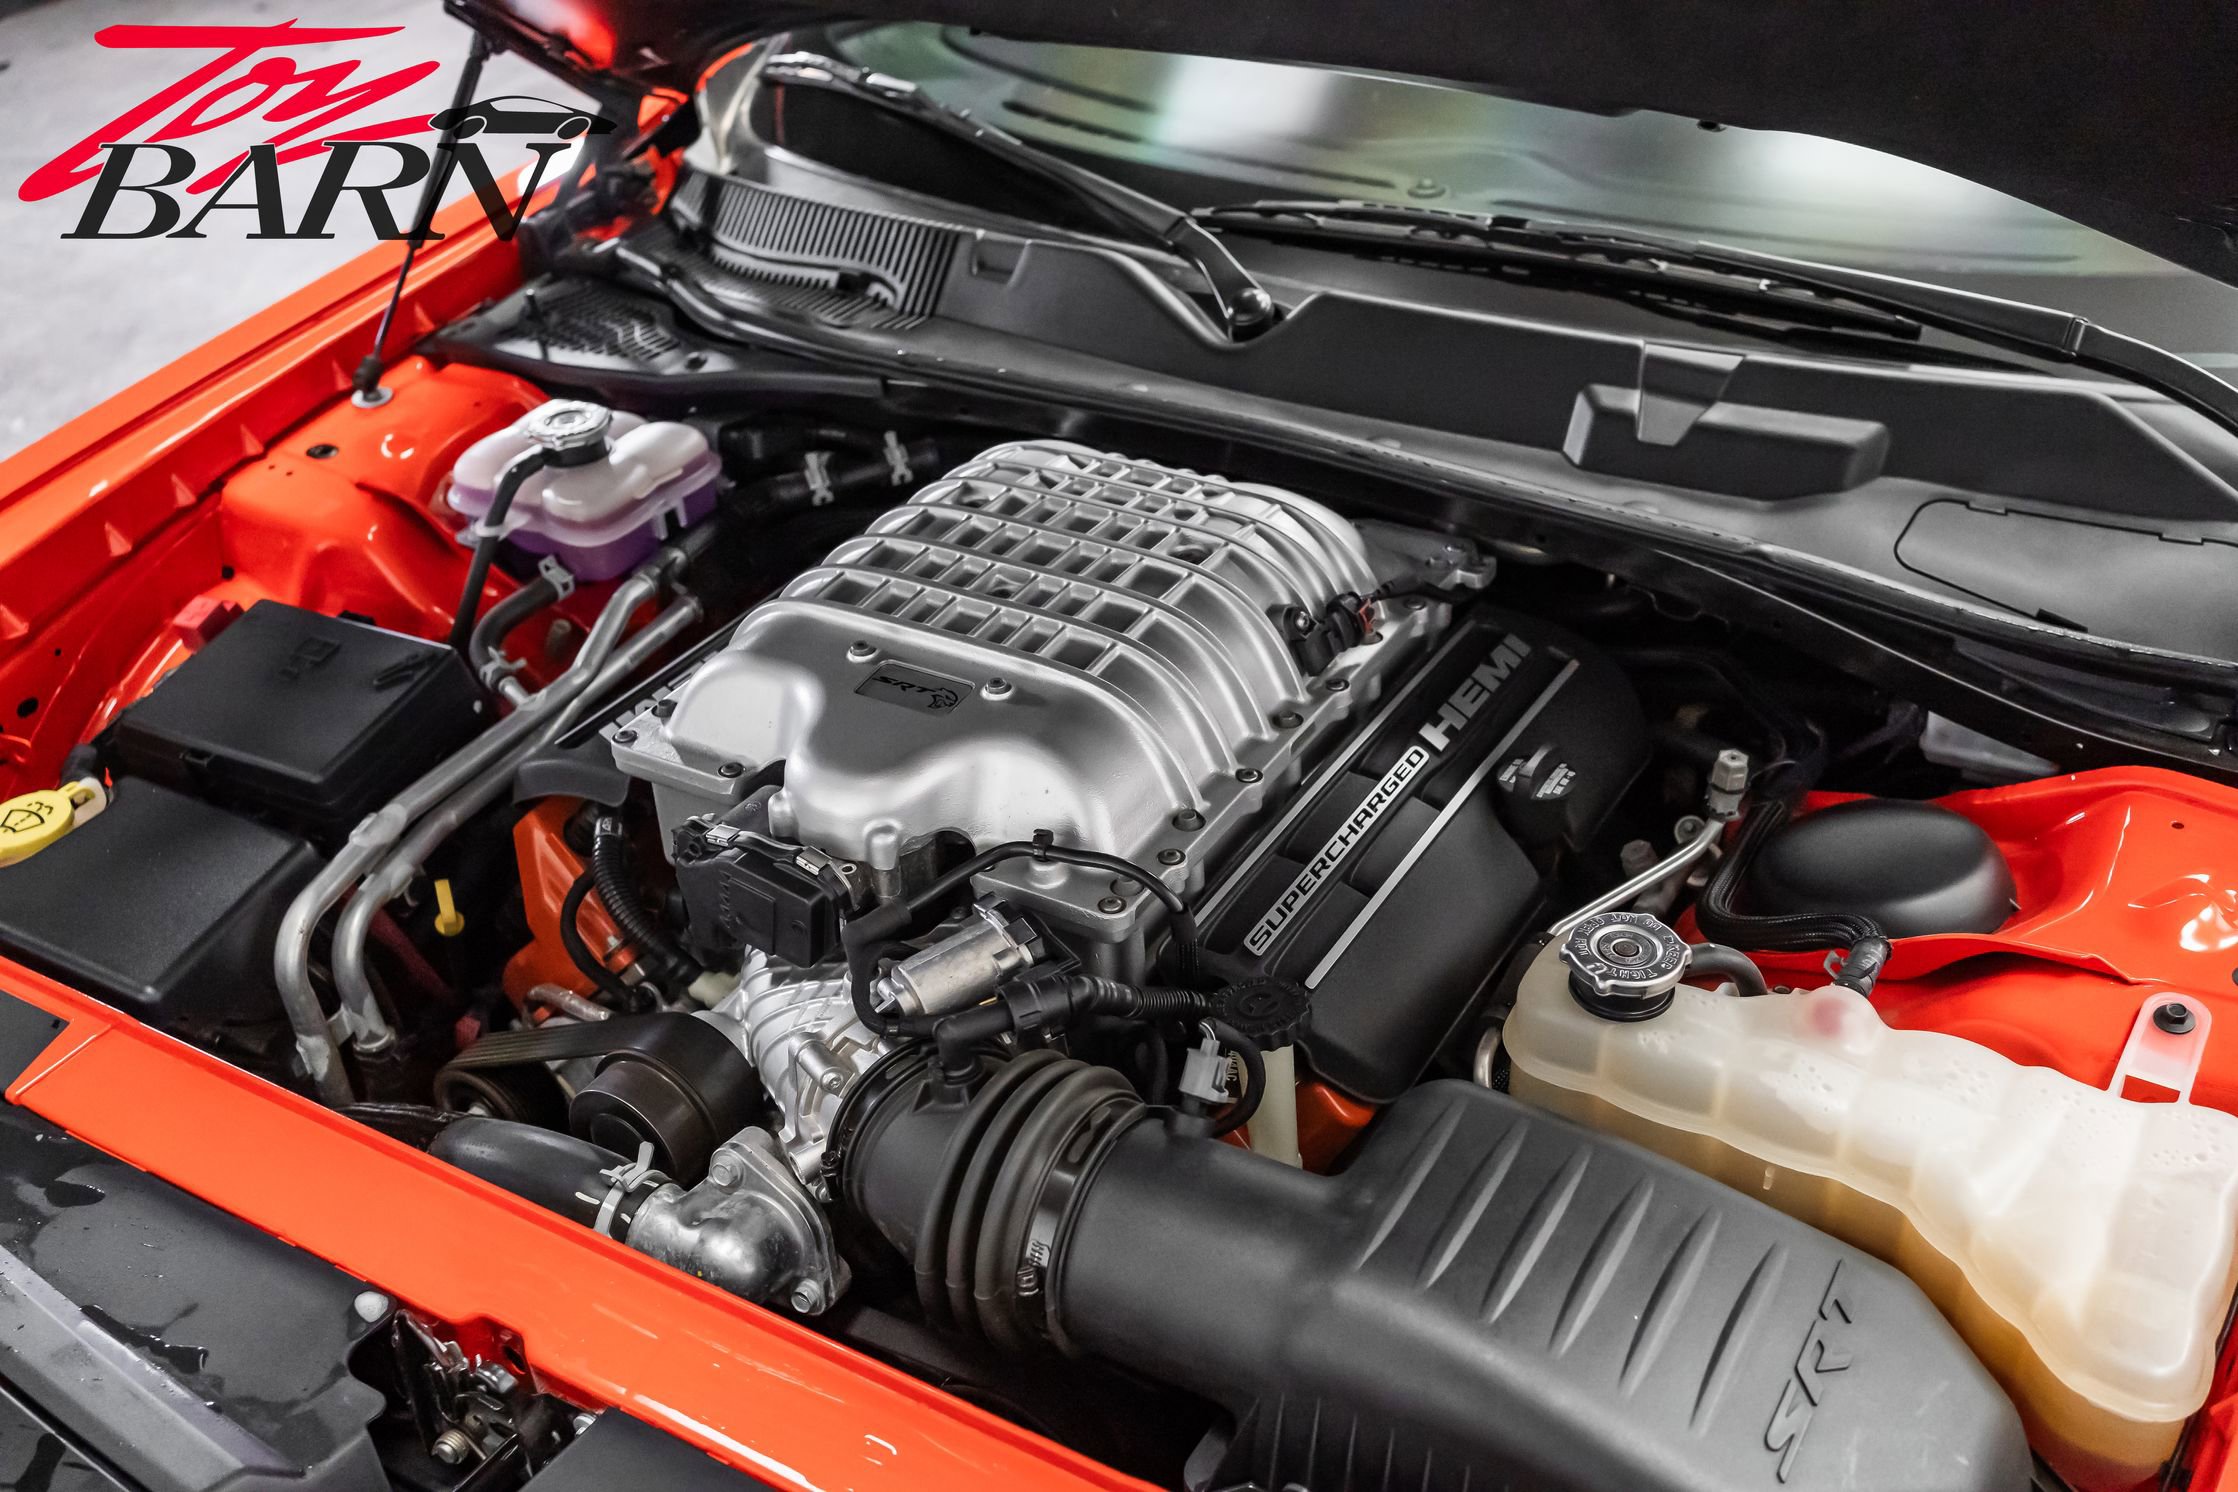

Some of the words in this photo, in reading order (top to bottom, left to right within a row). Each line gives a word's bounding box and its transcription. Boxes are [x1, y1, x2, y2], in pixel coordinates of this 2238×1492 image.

[872, 676, 937, 692] SRT
[1249, 748, 1425, 951] SUPERCHARGED
[1418, 633, 1532, 752] HEMI
[1662, 943, 1680, 970] KEEP
[1607, 968, 1658, 980] TIGHT
[1764, 1259, 1853, 1484] SRT
